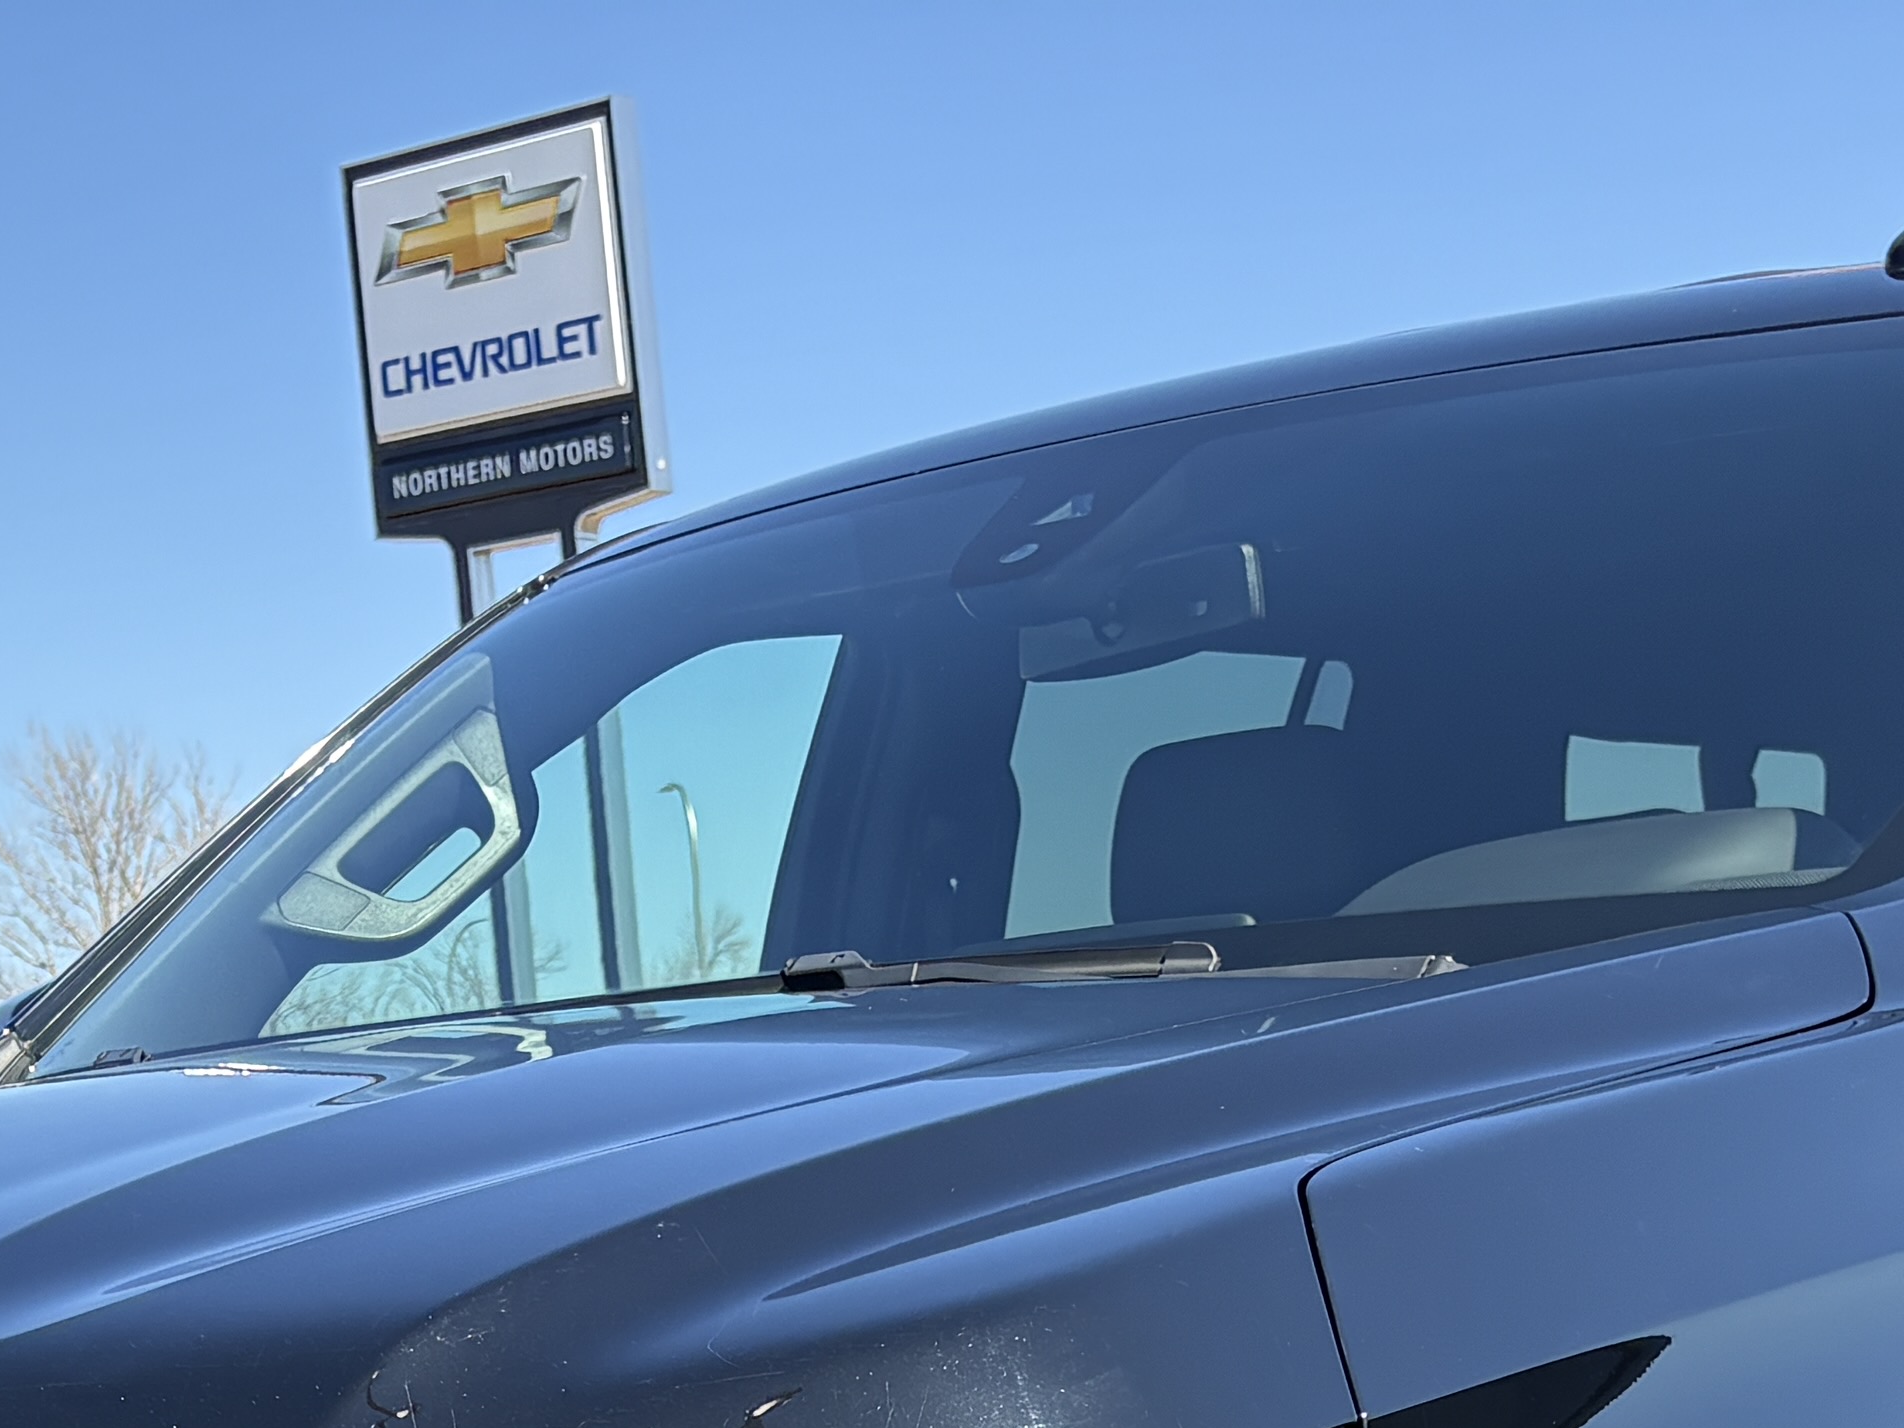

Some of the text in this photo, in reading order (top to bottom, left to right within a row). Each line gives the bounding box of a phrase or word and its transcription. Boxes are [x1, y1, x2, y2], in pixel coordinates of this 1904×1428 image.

[380, 314, 601, 398] CHEVROLET
[392, 433, 614, 499] NORTHERN MOTORS
